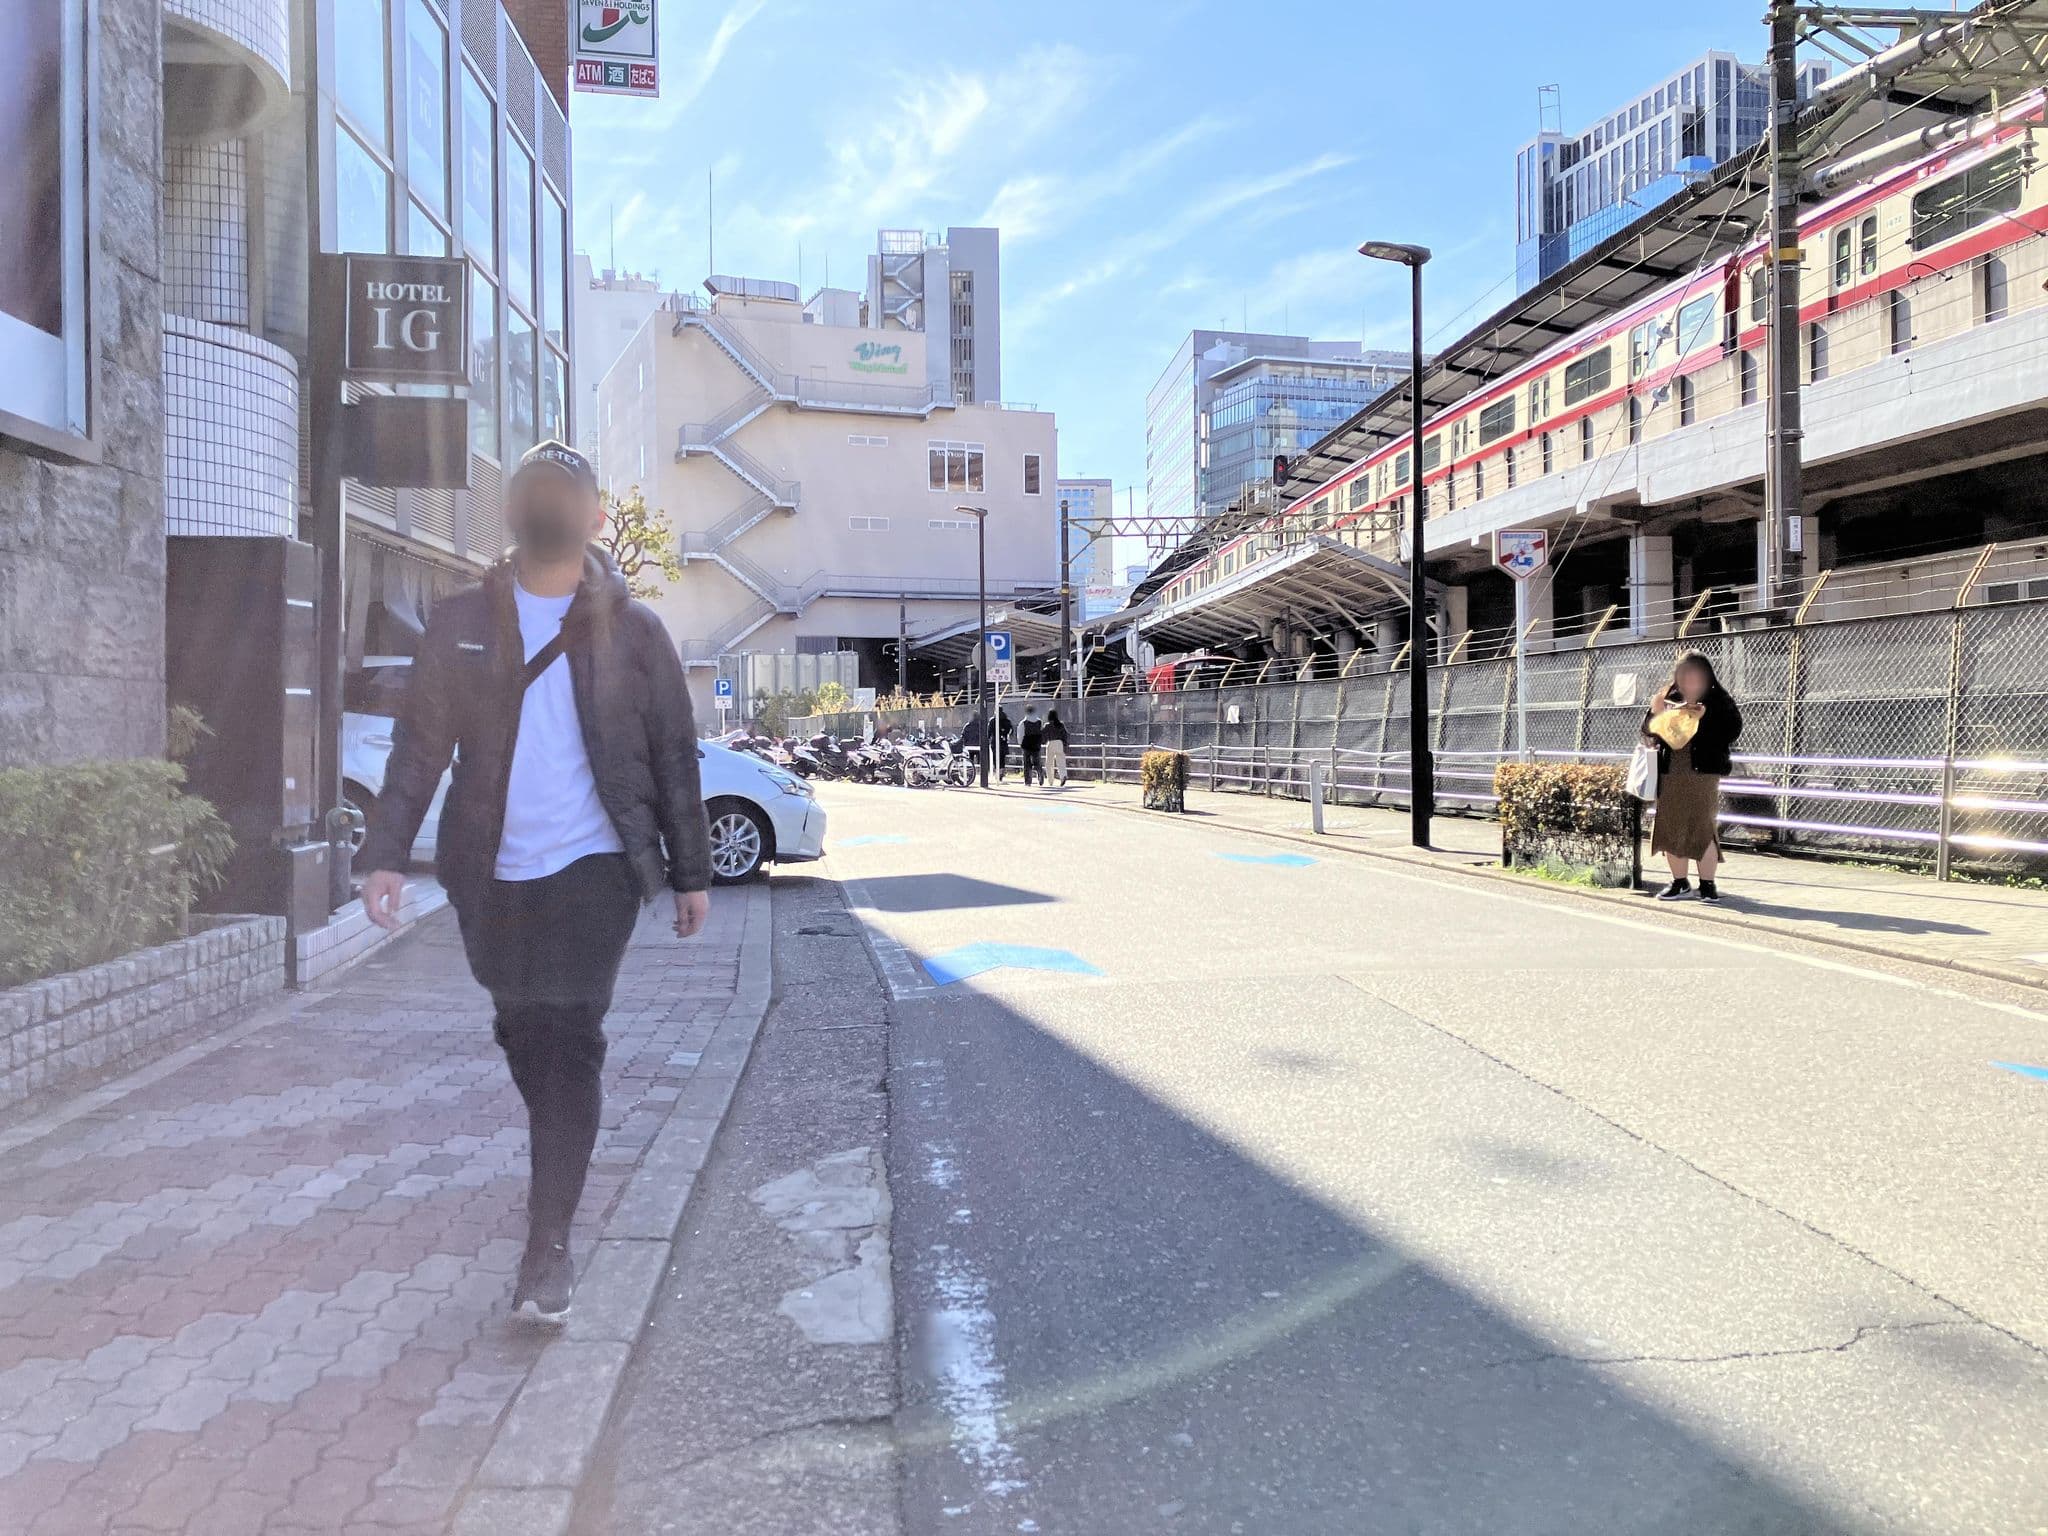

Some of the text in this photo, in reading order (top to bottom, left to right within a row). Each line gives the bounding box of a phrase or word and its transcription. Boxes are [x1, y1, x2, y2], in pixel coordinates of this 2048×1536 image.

[614, 1, 651, 12] HOLDINGS
[578, 64, 602, 82] ATM
[608, 66, 625, 83] 酒
[631, 68, 655, 85] たばこ
[366, 281, 451, 303] HOTEL
[373, 307, 441, 352] IG
[854, 341, 902, 363] Wing
[719, 681, 730, 695] P
